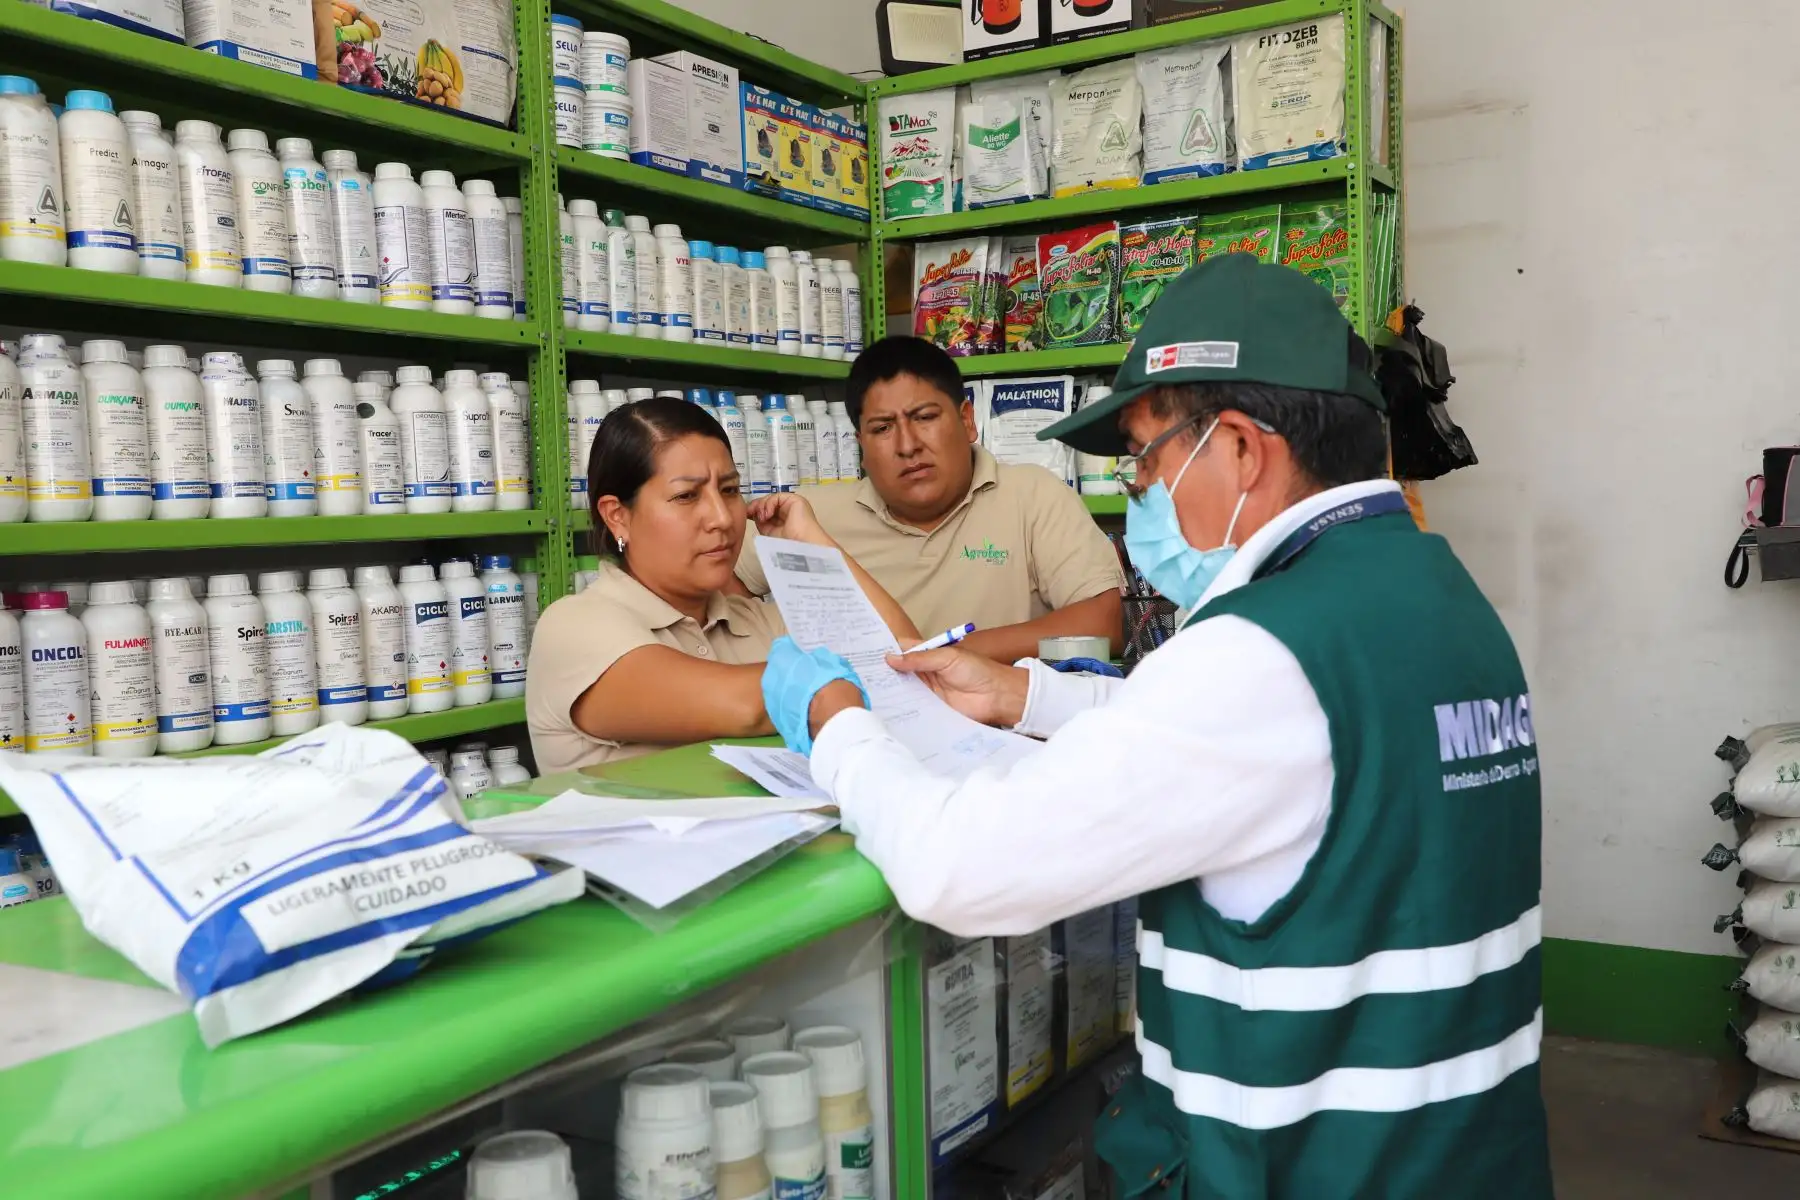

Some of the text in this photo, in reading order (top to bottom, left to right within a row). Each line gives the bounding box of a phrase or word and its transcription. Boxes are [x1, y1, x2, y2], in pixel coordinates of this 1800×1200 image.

[1259, 25, 1318, 48] FITOZEB
[1069, 89, 1105, 101] Merpan
[982, 132, 1009, 144] Aliette
[90, 147, 119, 159] Predict
[22, 387, 79, 400] ARMADA
[996, 388, 1060, 401] MALATHION
[1309, 502, 1364, 532] SENASA
[31, 646, 83, 662] ONCOL
[267, 839, 508, 918] LIGERAMENTE PELIGROSO
[353, 875, 448, 914] CUIDADO
